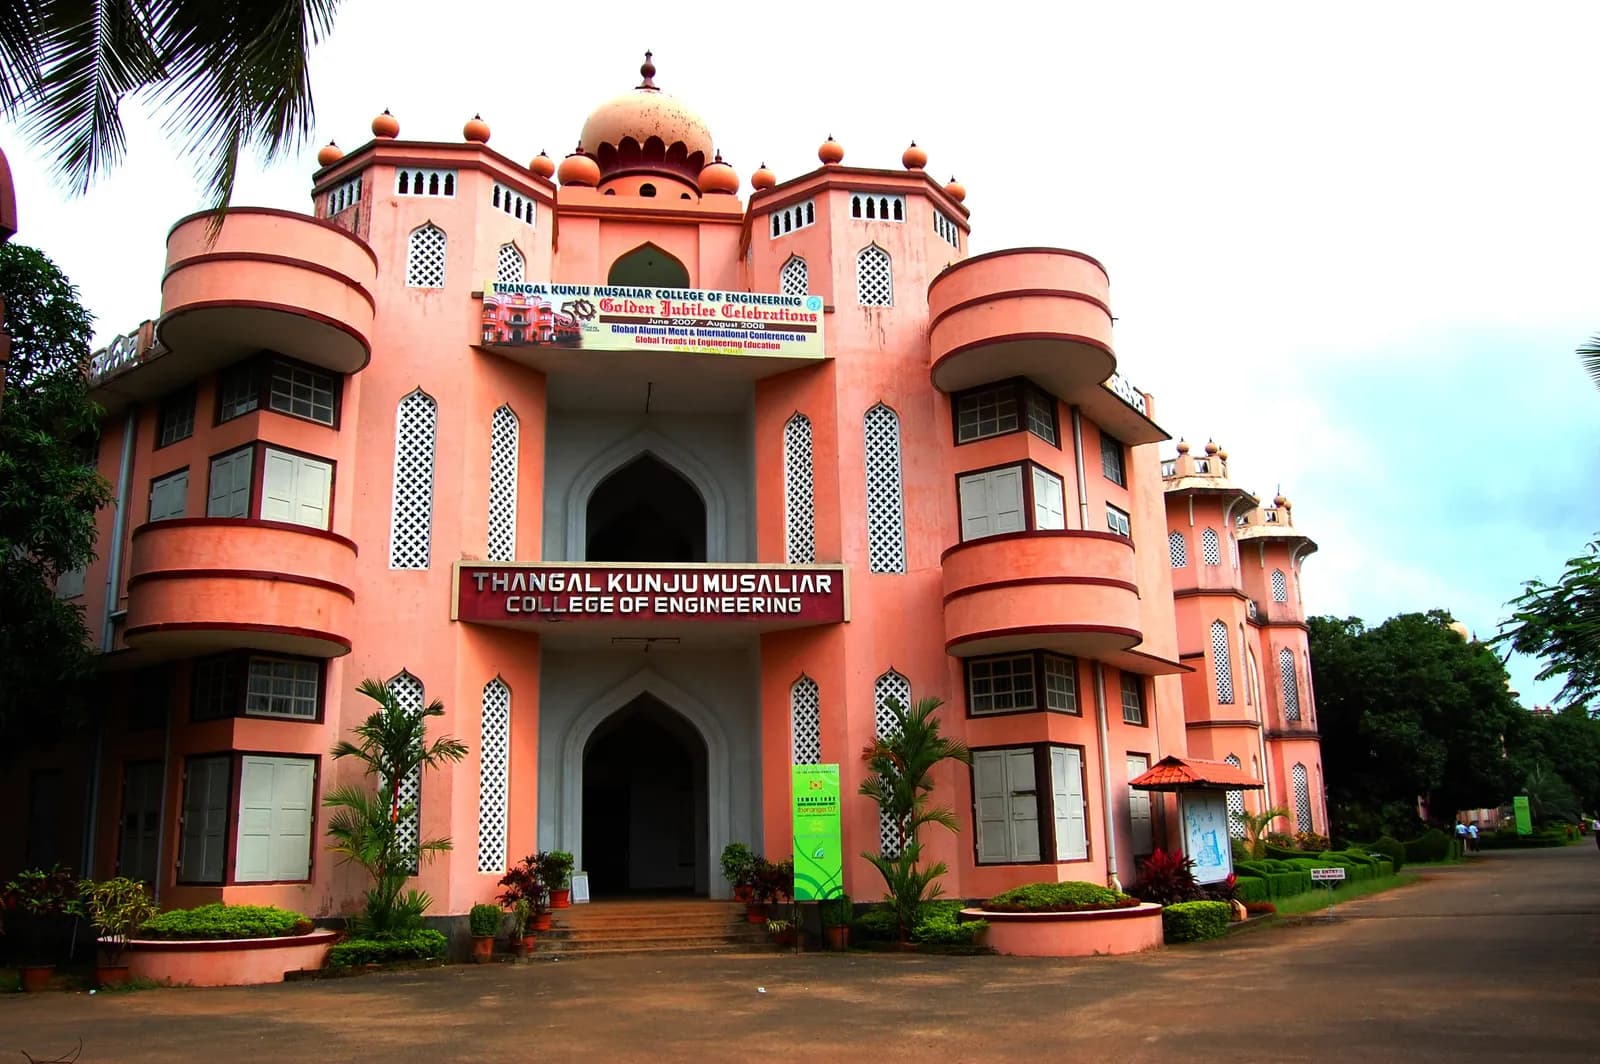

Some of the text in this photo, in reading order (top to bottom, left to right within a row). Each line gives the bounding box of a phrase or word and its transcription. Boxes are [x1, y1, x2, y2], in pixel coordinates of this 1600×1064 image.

[493, 283, 802, 306] THANGAL KUNJU MUSALIAR COLLEGE OF ENGINEERING
[599, 298, 817, 322] Golden Jubilee Celebrations
[672, 318, 697, 326] 2007
[706, 320, 738, 329] August
[741, 321, 765, 330] 2008
[611, 325, 806, 342] Global Alumni Meet & International Conference on
[635, 336, 659, 344] Global
[661, 337, 687, 345] Trends
[688, 338, 696, 346] in
[697, 338, 743, 349] Engineering
[744, 340, 781, 350] Education
[472, 572, 832, 593] THANGAL KUNJU MUSALIAR
[506, 596, 801, 613] COLLEGE OF ENGINEERING
